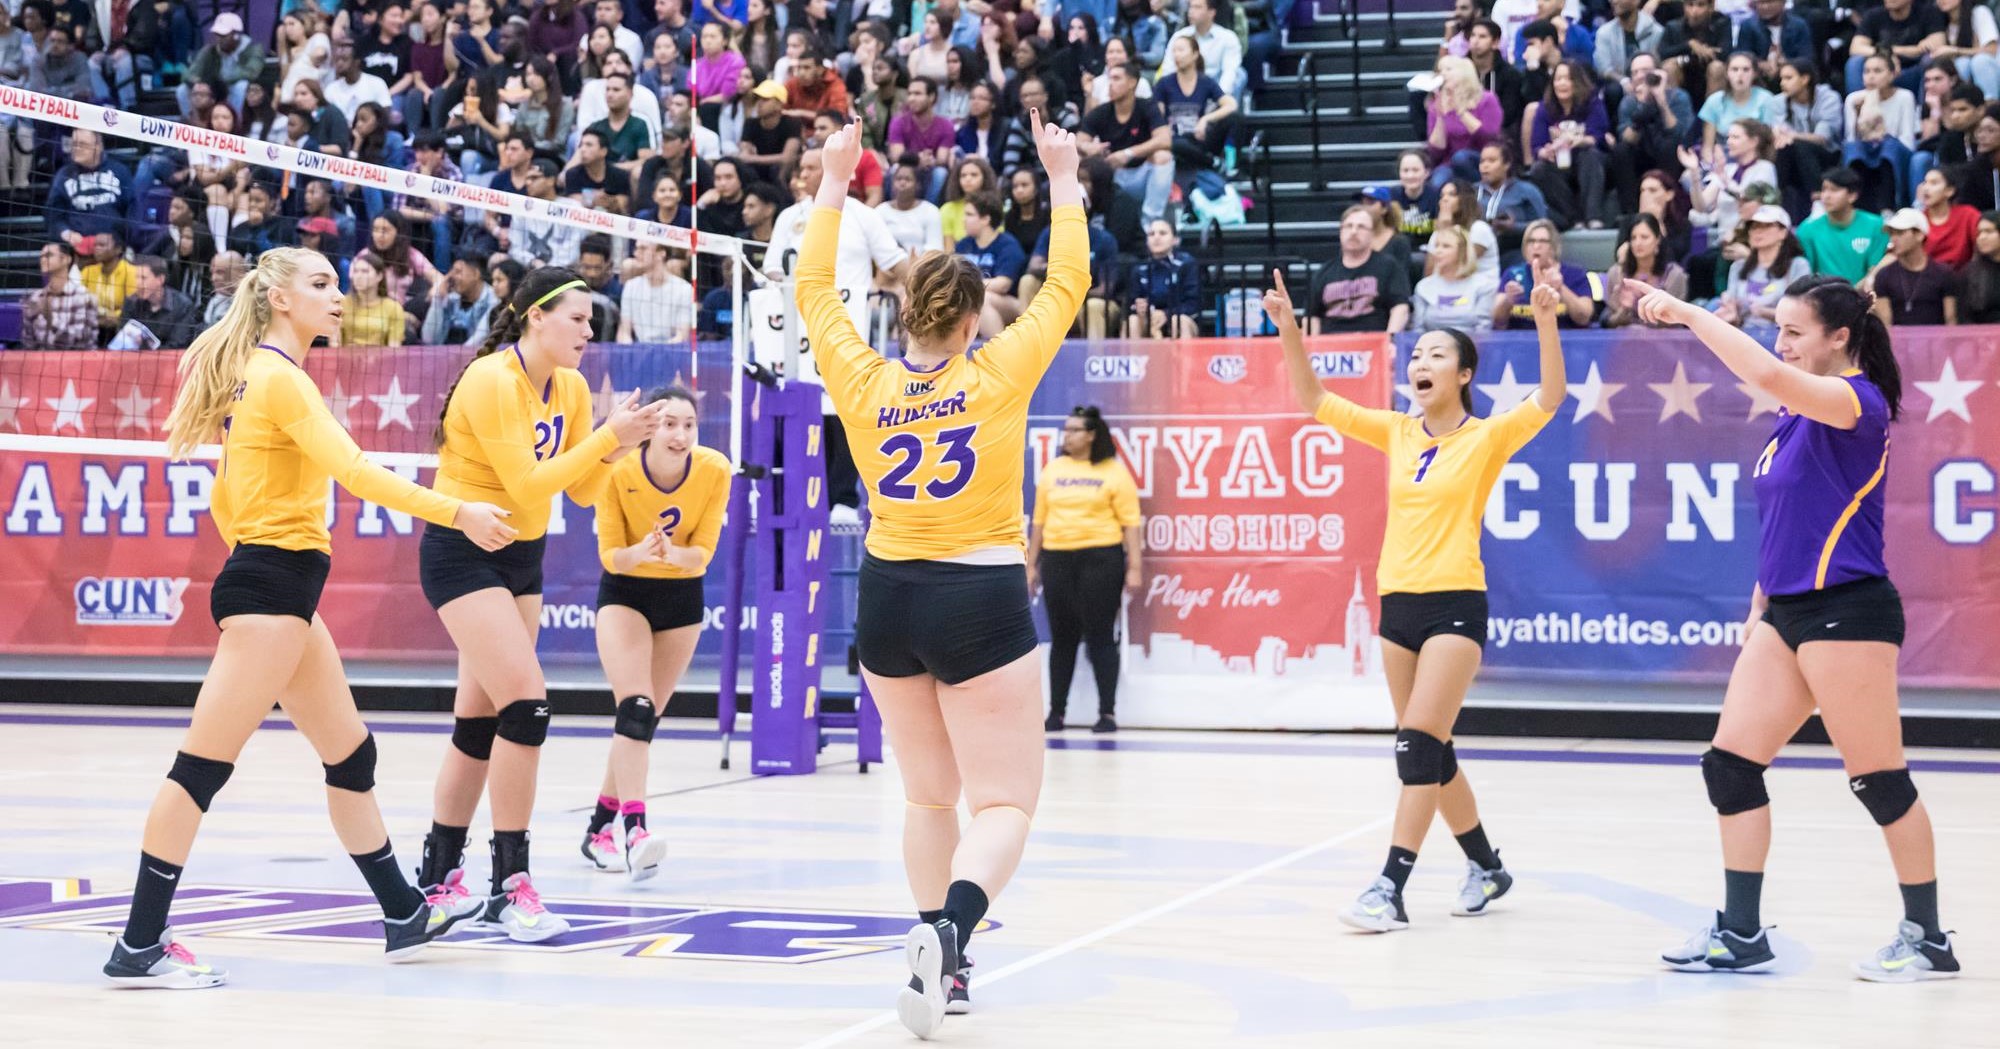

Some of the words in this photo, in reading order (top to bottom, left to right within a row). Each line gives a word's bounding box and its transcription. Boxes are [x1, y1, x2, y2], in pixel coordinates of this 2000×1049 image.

[0, 88, 79, 120] OLLEYBALL
[877, 390, 967, 429] HUNTER
[534, 414, 564, 462] 21
[878, 424, 978, 500] 23
[659, 506, 682, 537] 2
[1484, 463, 1740, 542] CUN
[77, 577, 190, 615] CUNY
[804, 424, 822, 720] HUNTER
[1144, 574, 1214, 620] Plays
[1220, 572, 1282, 608] Here
